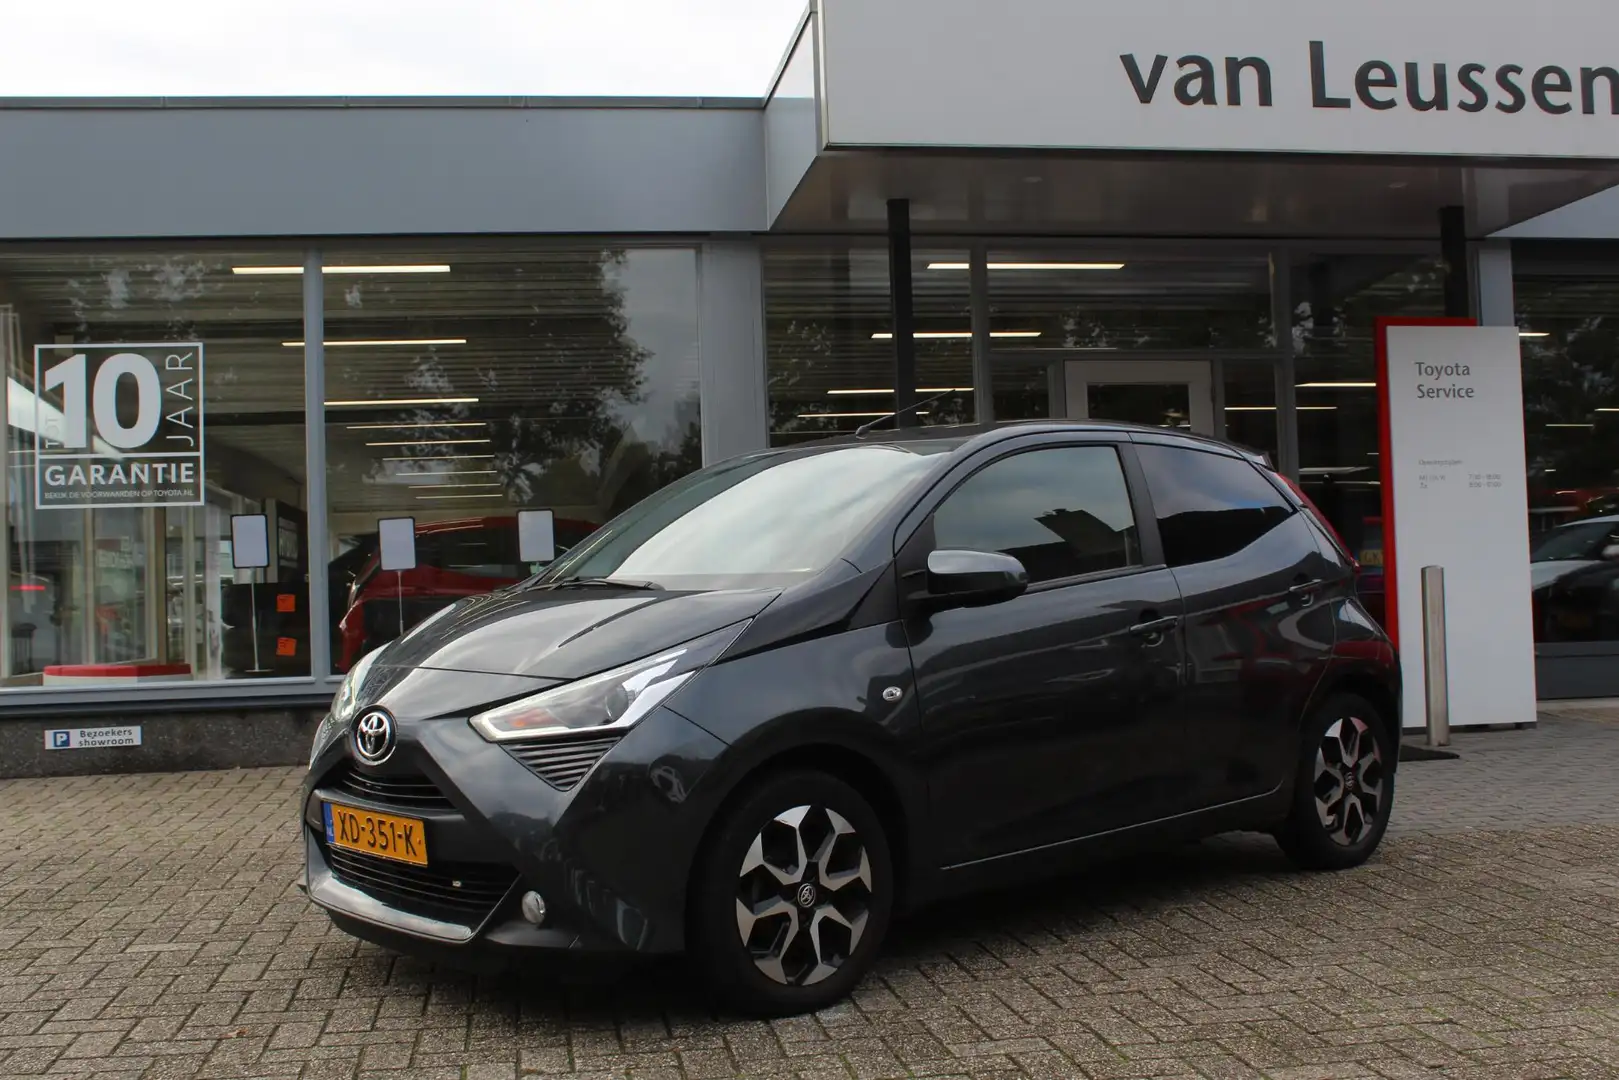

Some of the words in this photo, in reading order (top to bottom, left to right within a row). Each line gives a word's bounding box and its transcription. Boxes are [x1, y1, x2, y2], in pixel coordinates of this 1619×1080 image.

[1119, 53, 1273, 107] van
[1308, 40, 1619, 115] Leussen
[1414, 361, 1470, 381] Toyota
[45, 353, 161, 449] 10
[165, 352, 194, 447] JAAR
[1416, 383, 1475, 399] Service
[44, 462, 195, 486] GARANTIE
[79, 736, 134, 747] showroom
[80, 728, 133, 738] Bezoekers
[338, 810, 417, 857] XD-351-K
